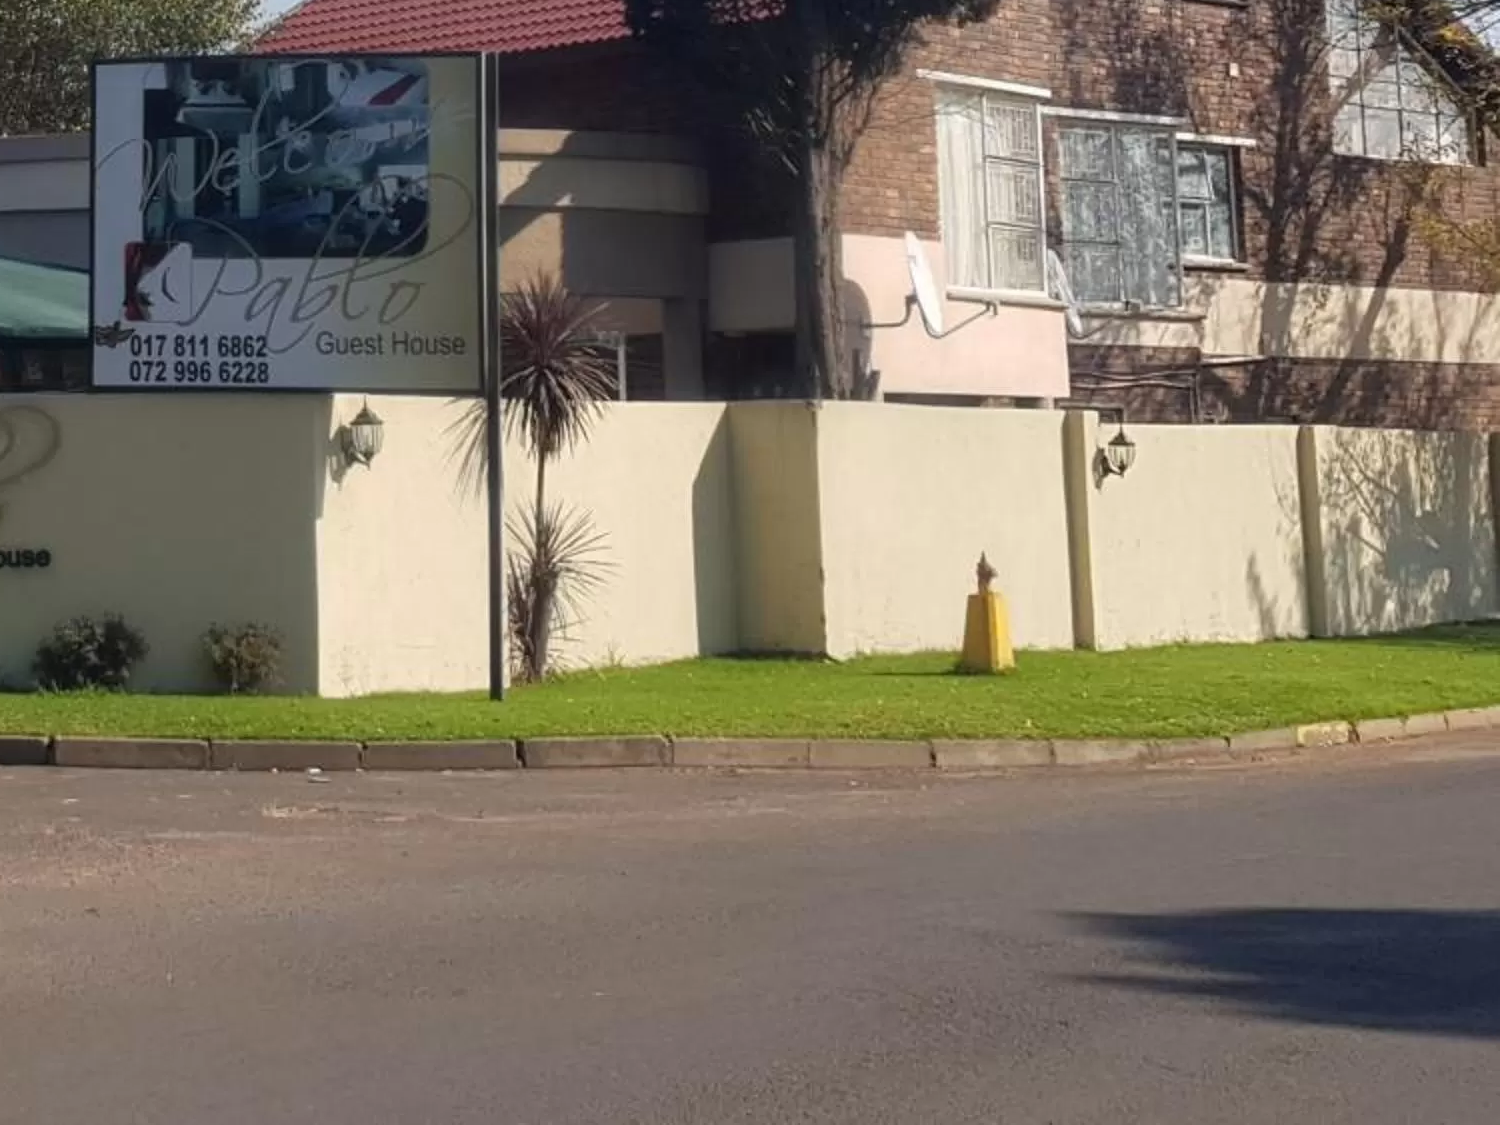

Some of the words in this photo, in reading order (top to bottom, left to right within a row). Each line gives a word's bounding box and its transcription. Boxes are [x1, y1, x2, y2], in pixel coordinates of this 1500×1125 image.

[167, 174, 474, 354] Pablo
[130, 335, 167, 358] 017
[173, 335, 210, 358] 811
[217, 334, 268, 358] 6862
[315, 331, 384, 356] Guest
[391, 331, 466, 356] House
[129, 361, 167, 383] 072
[173, 361, 211, 383] 996
[218, 361, 269, 383] 6228
